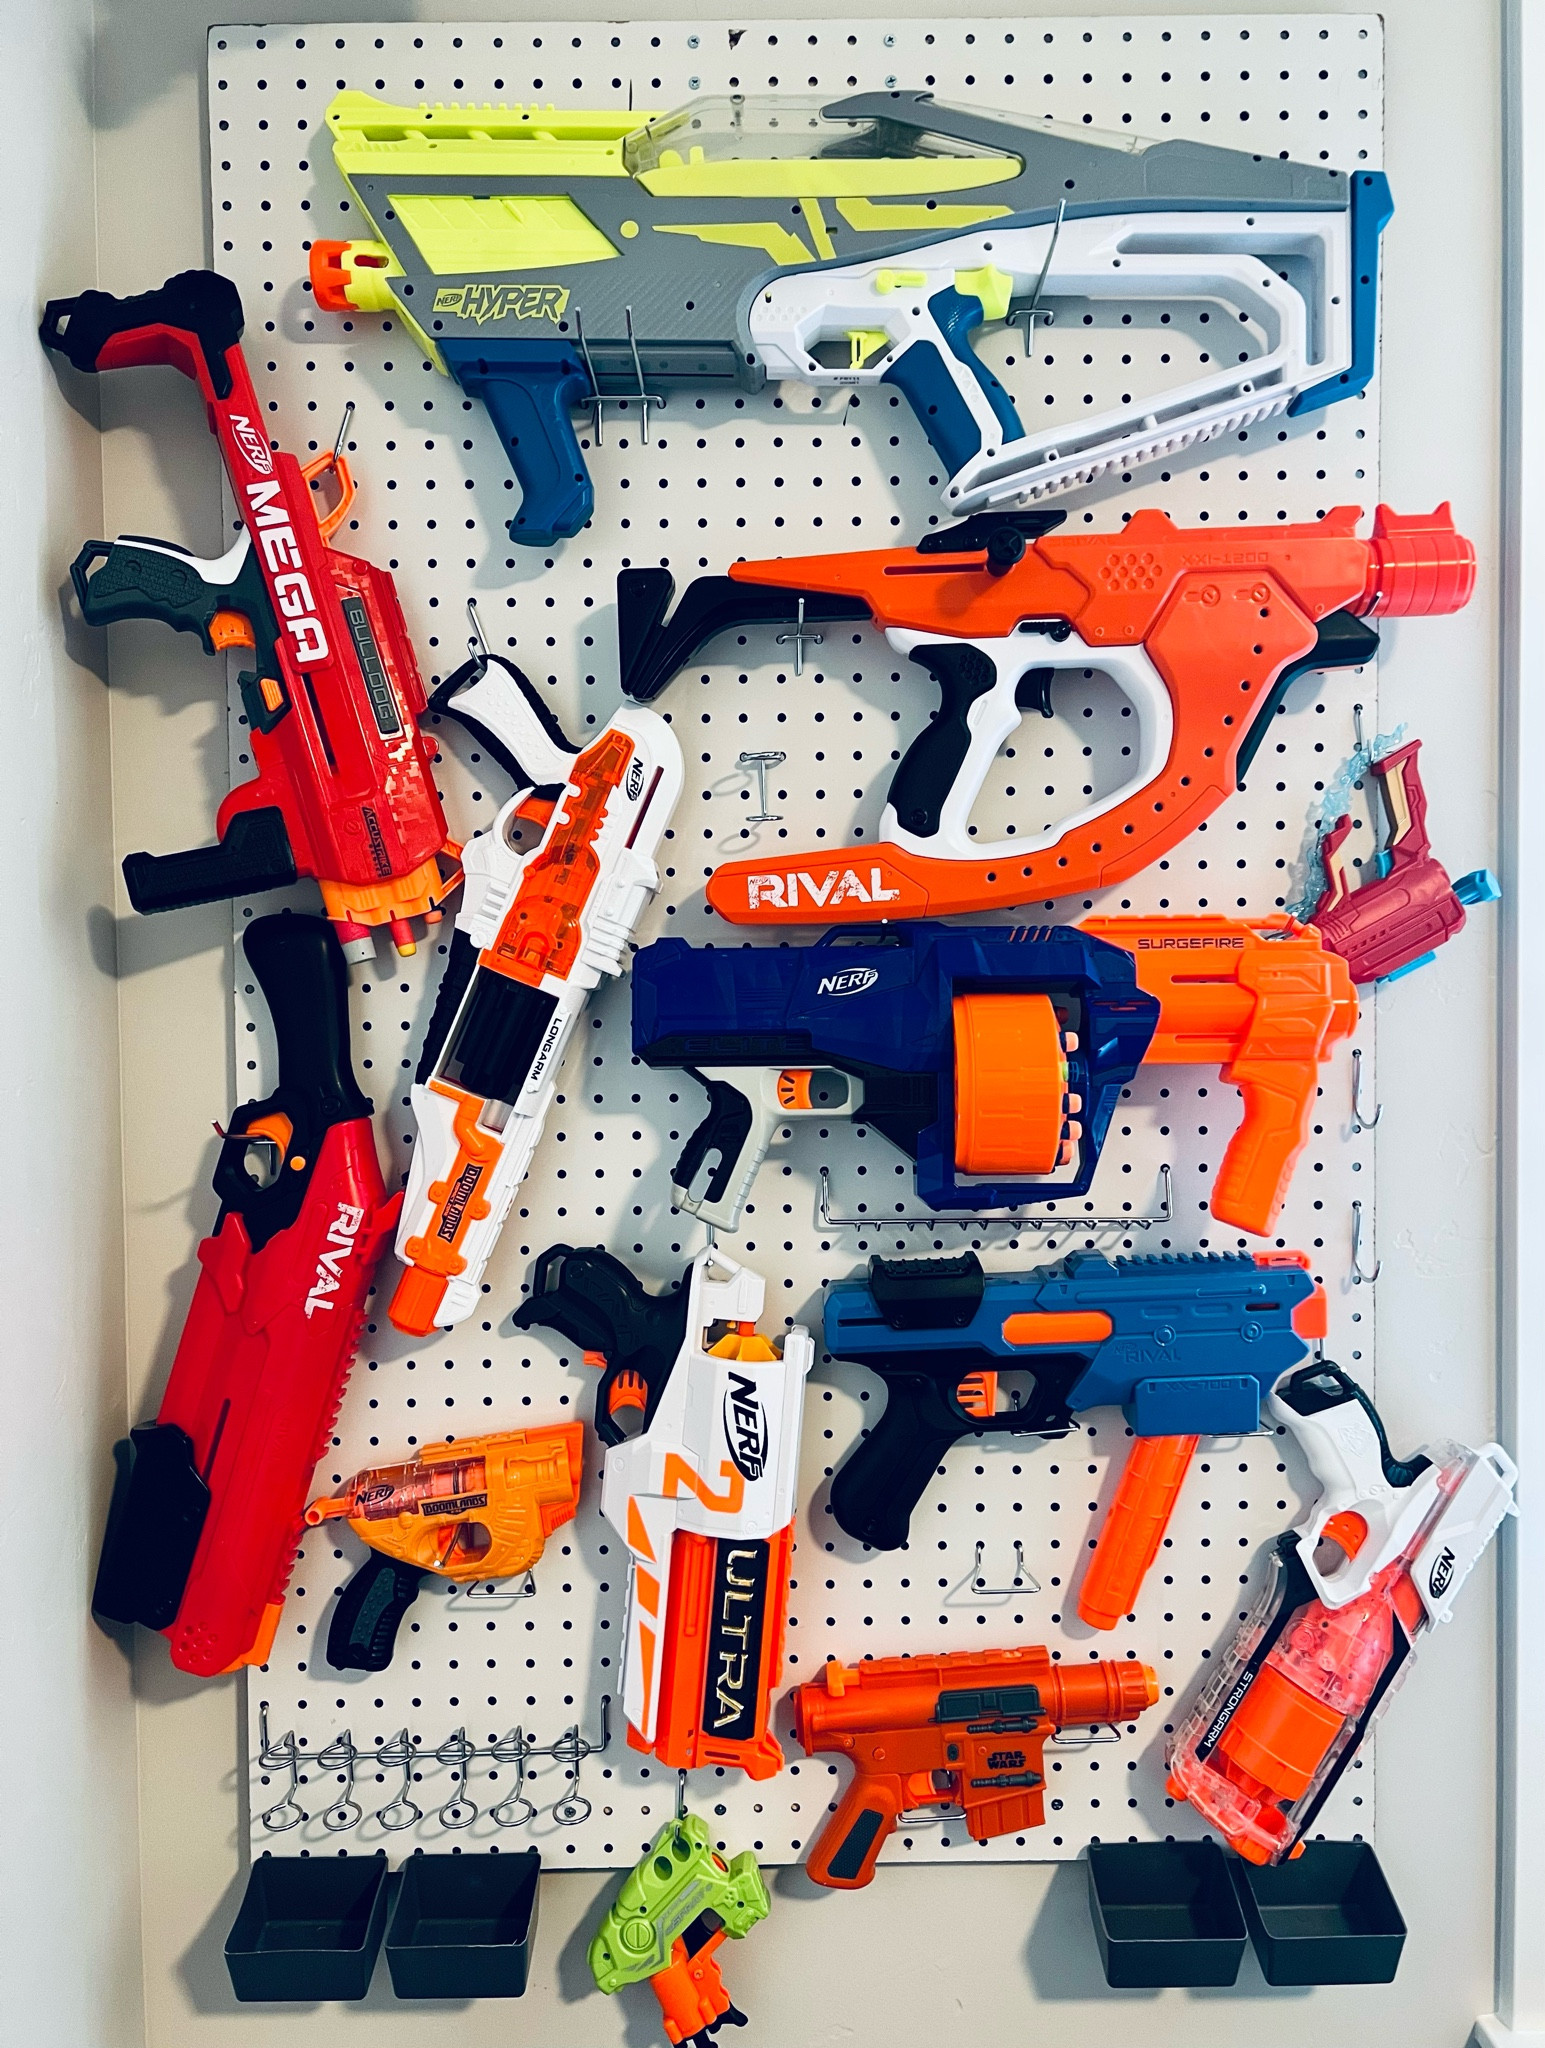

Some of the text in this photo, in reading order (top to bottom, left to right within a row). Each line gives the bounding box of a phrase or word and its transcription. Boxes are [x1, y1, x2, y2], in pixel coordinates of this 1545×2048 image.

[436, 286, 563, 321] NERF HYPER
[229, 414, 329, 663] NERF MEGA
[349, 609, 394, 720] BULLDOG
[628, 757, 644, 801] NERF
[363, 808, 392, 876] ACCUSTRIKE
[747, 867, 901, 910] RIVAL
[1137, 937, 1244, 949] SURGEFIRE
[817, 968, 878, 996] NERF
[530, 1017, 563, 1081] LONGARM
[440, 1165, 480, 1241] DOOMLANDS
[304, 1201, 365, 1319] RIVAL
[725, 1371, 768, 1481] NERF
[355, 1484, 395, 1506] NERF
[424, 1494, 486, 1515] DOOMLANDS
[663, 1453, 745, 1514] 2
[1430, 1546, 1456, 1599] NERF
[713, 1549, 757, 1729] ULTRA
[1203, 1671, 1254, 1748] STRONGARM
[987, 1750, 1026, 1761] STAR
[987, 1759, 1026, 1770] WARS
